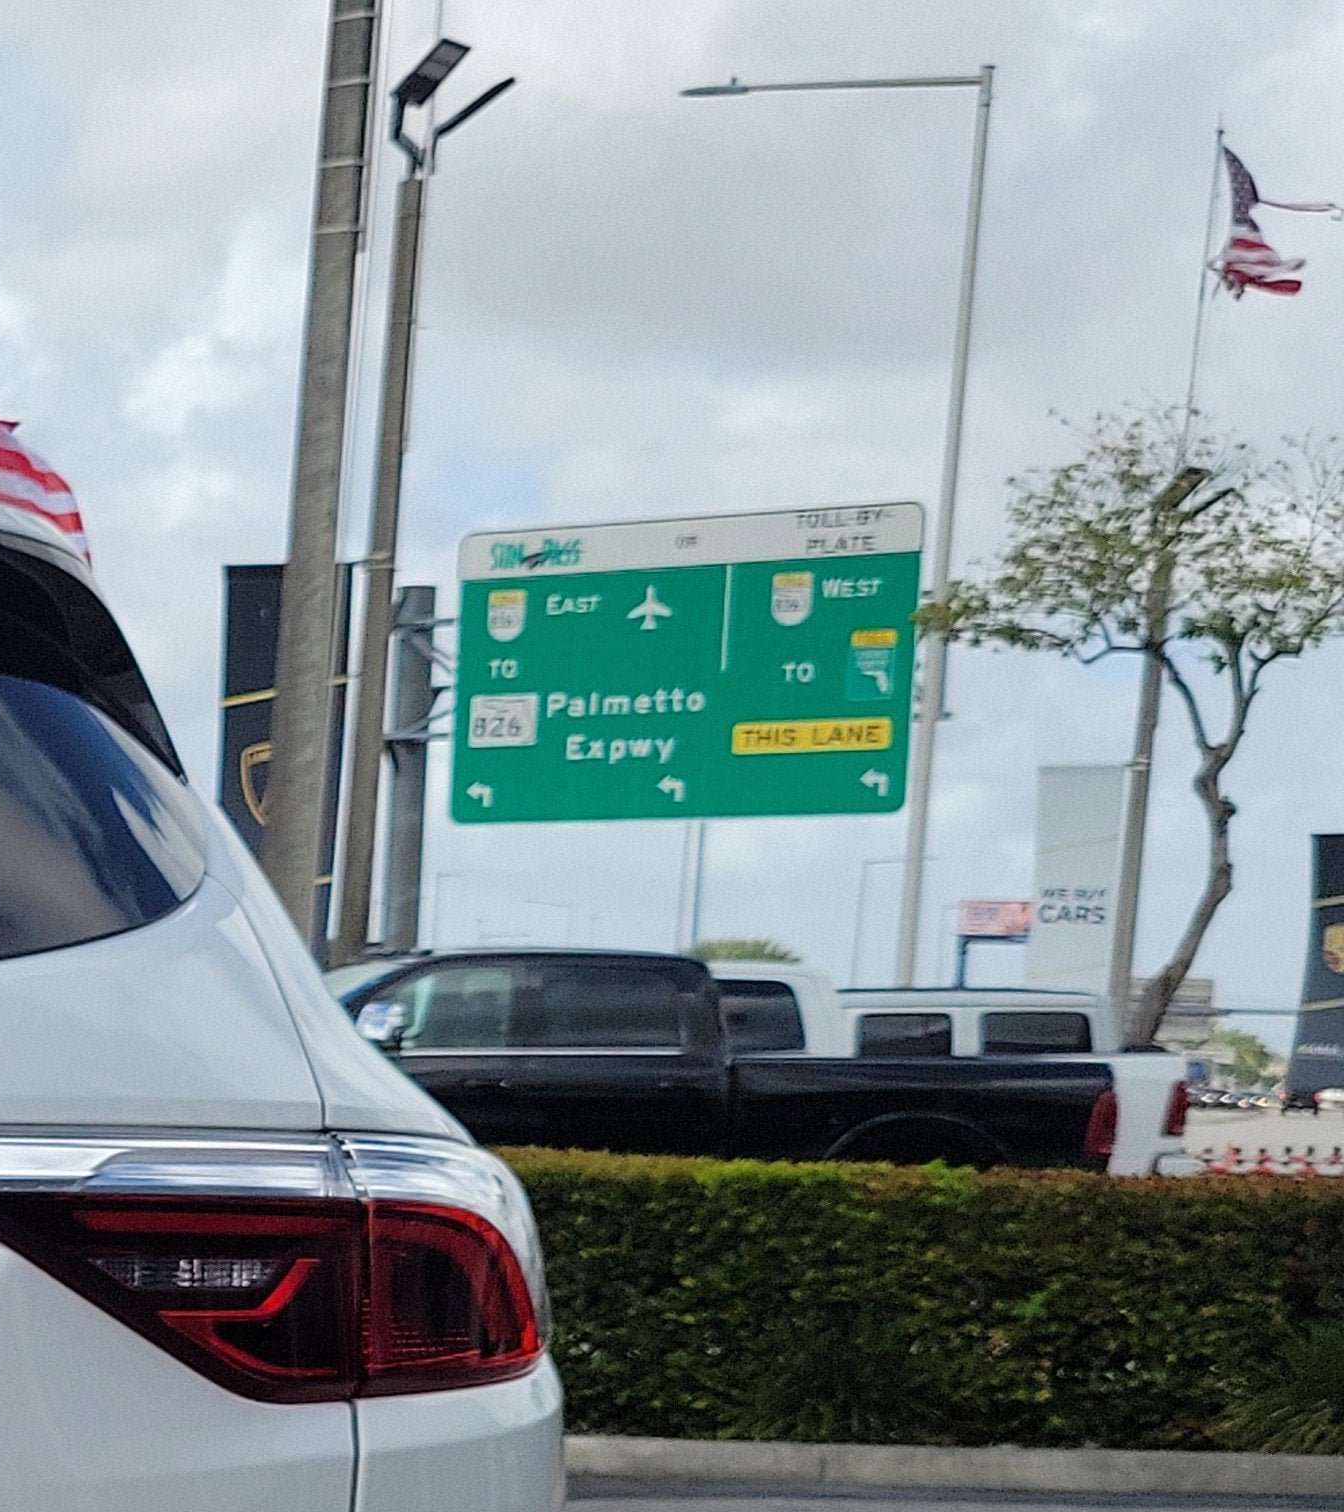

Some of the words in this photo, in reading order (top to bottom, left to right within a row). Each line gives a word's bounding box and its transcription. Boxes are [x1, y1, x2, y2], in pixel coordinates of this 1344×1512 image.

[805, 536, 876, 554] PLATE
[821, 578, 882, 598] WEST
[546, 593, 603, 616] EAST
[487, 658, 519, 680] TO
[782, 660, 816, 683] TO
[546, 687, 707, 718] Palmetto
[473, 716, 523, 738] 826
[743, 728, 797, 747] THIS
[813, 724, 882, 745] LANE
[565, 733, 676, 764] Expwy
[1039, 904, 1105, 924] CARS
